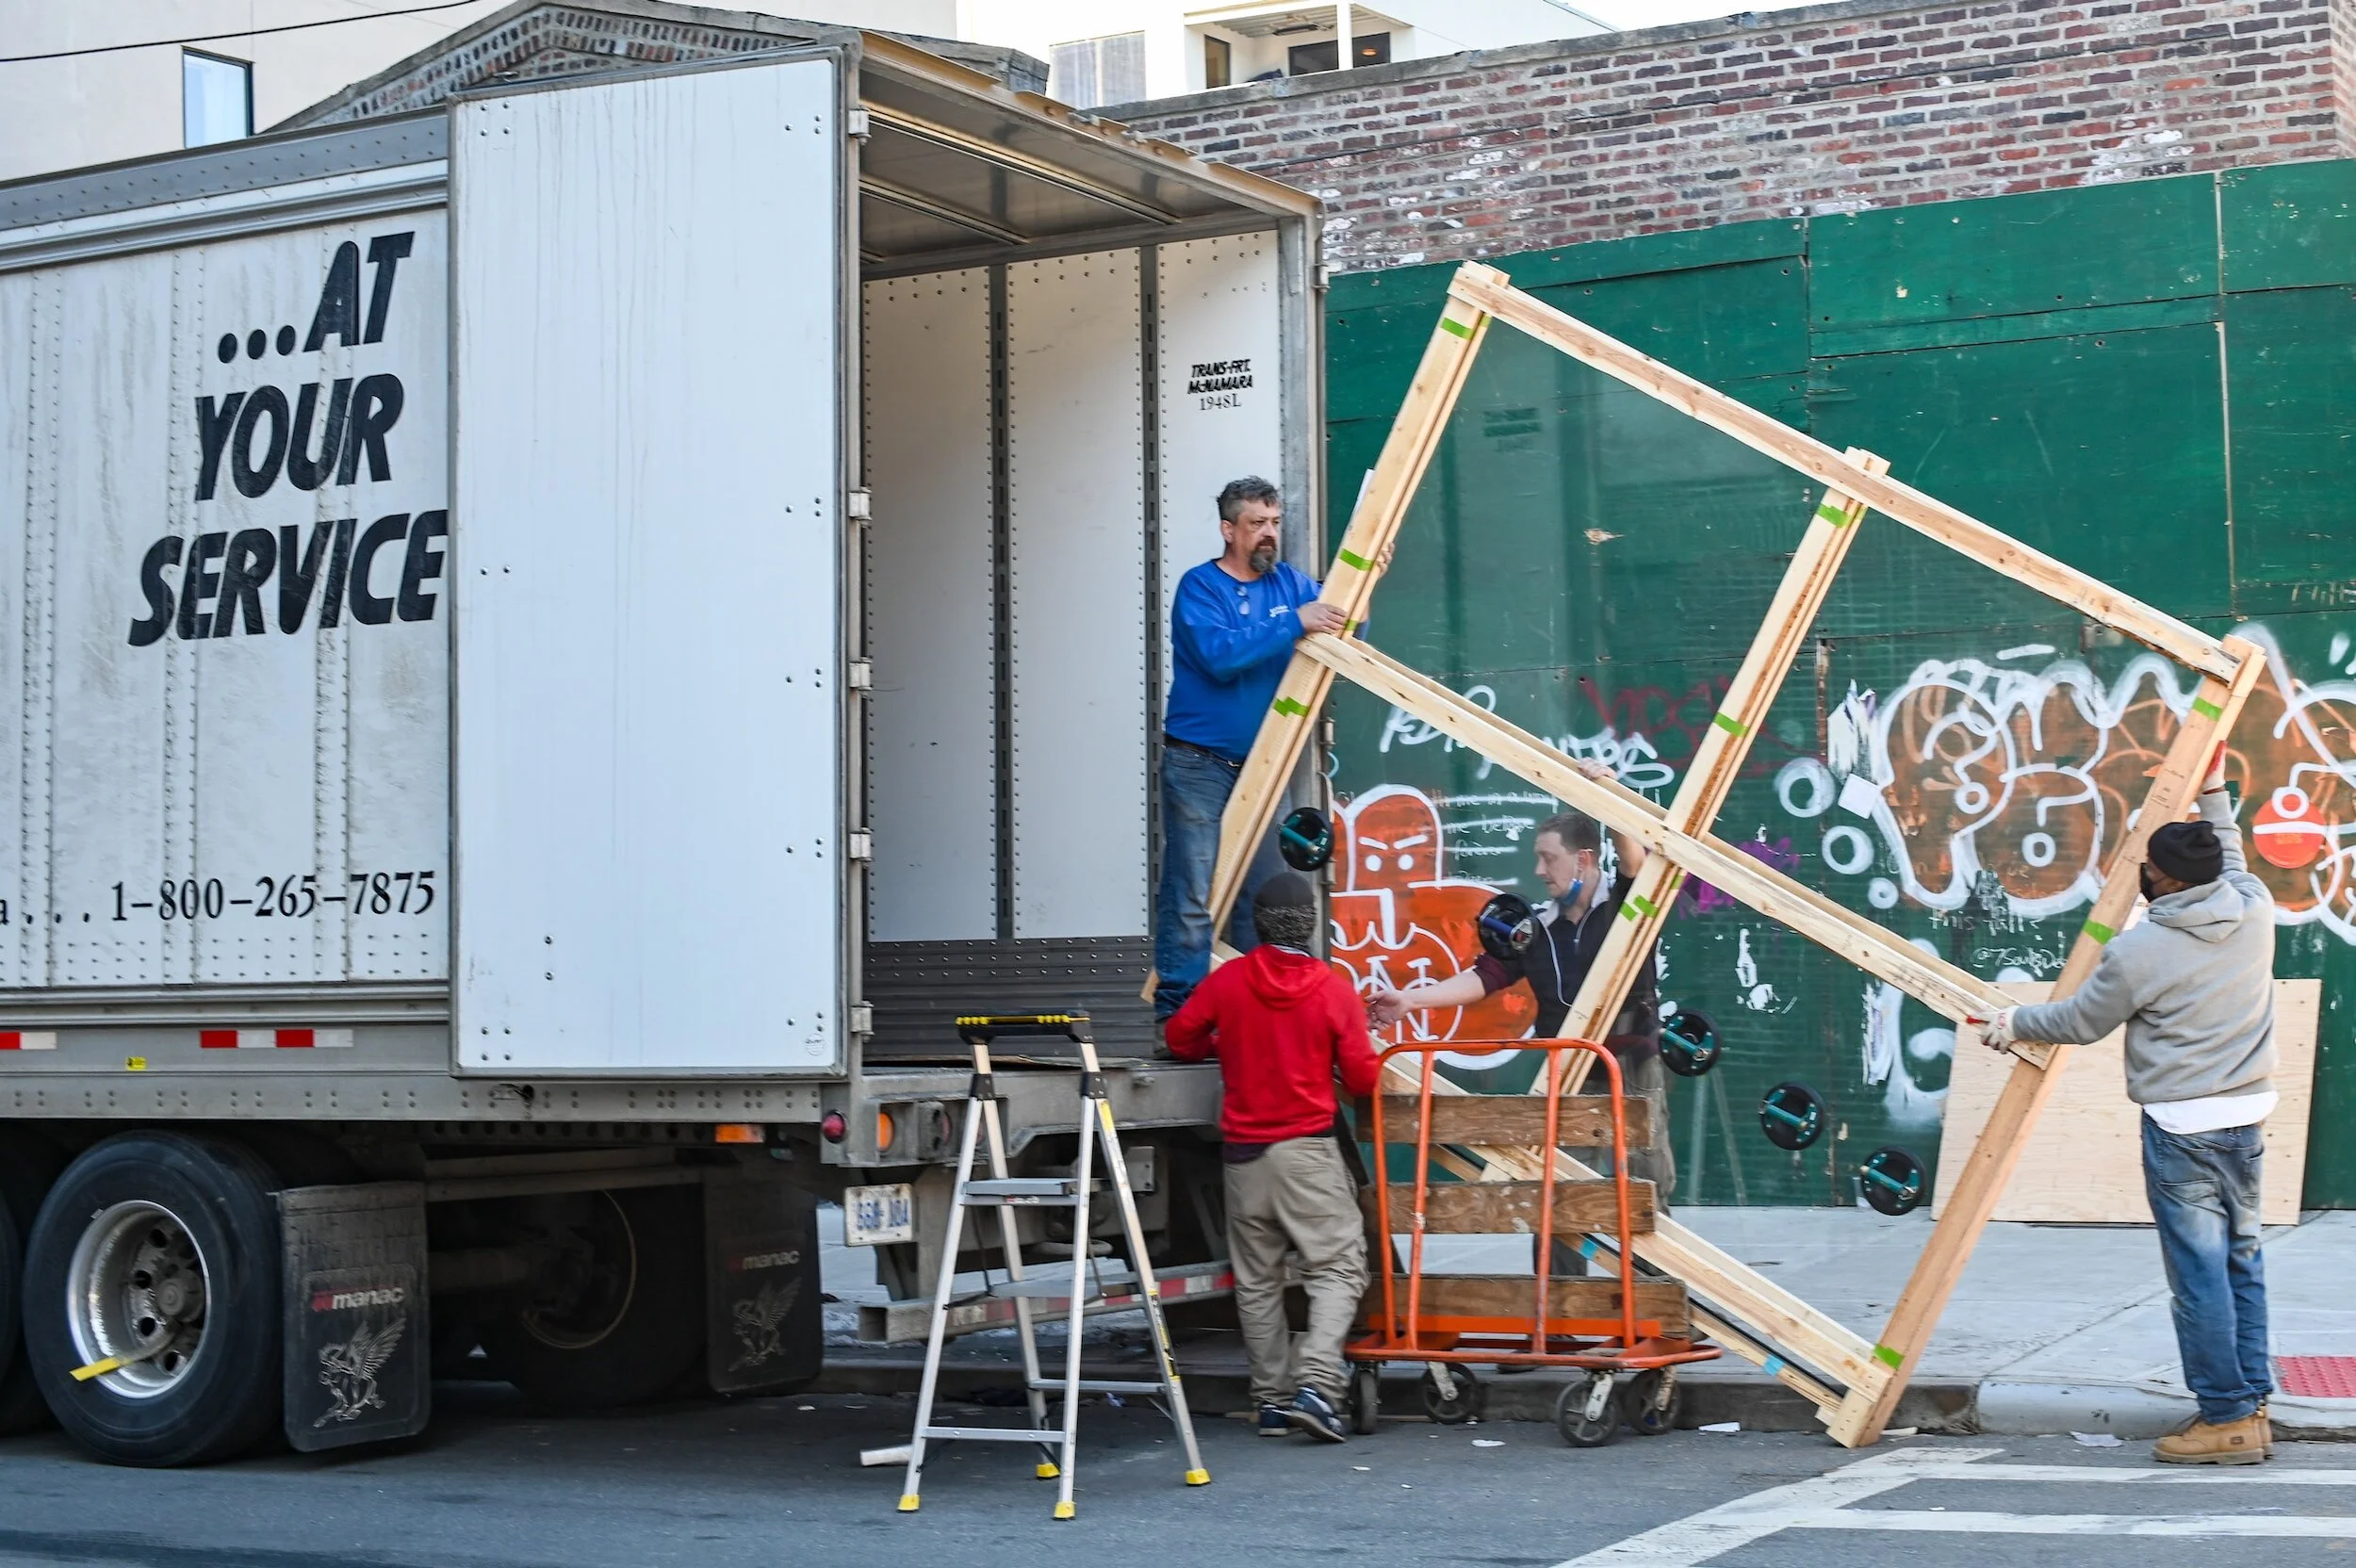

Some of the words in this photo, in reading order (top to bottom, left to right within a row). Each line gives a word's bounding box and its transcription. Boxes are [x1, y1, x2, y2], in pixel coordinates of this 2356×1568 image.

[194, 373, 404, 501] YOUR
[127, 509, 448, 647] SERVICE
[111, 870, 435, 922] 1-800-265-7875
[743, 1250, 800, 1270] manac
[332, 1287, 404, 1310] manac
